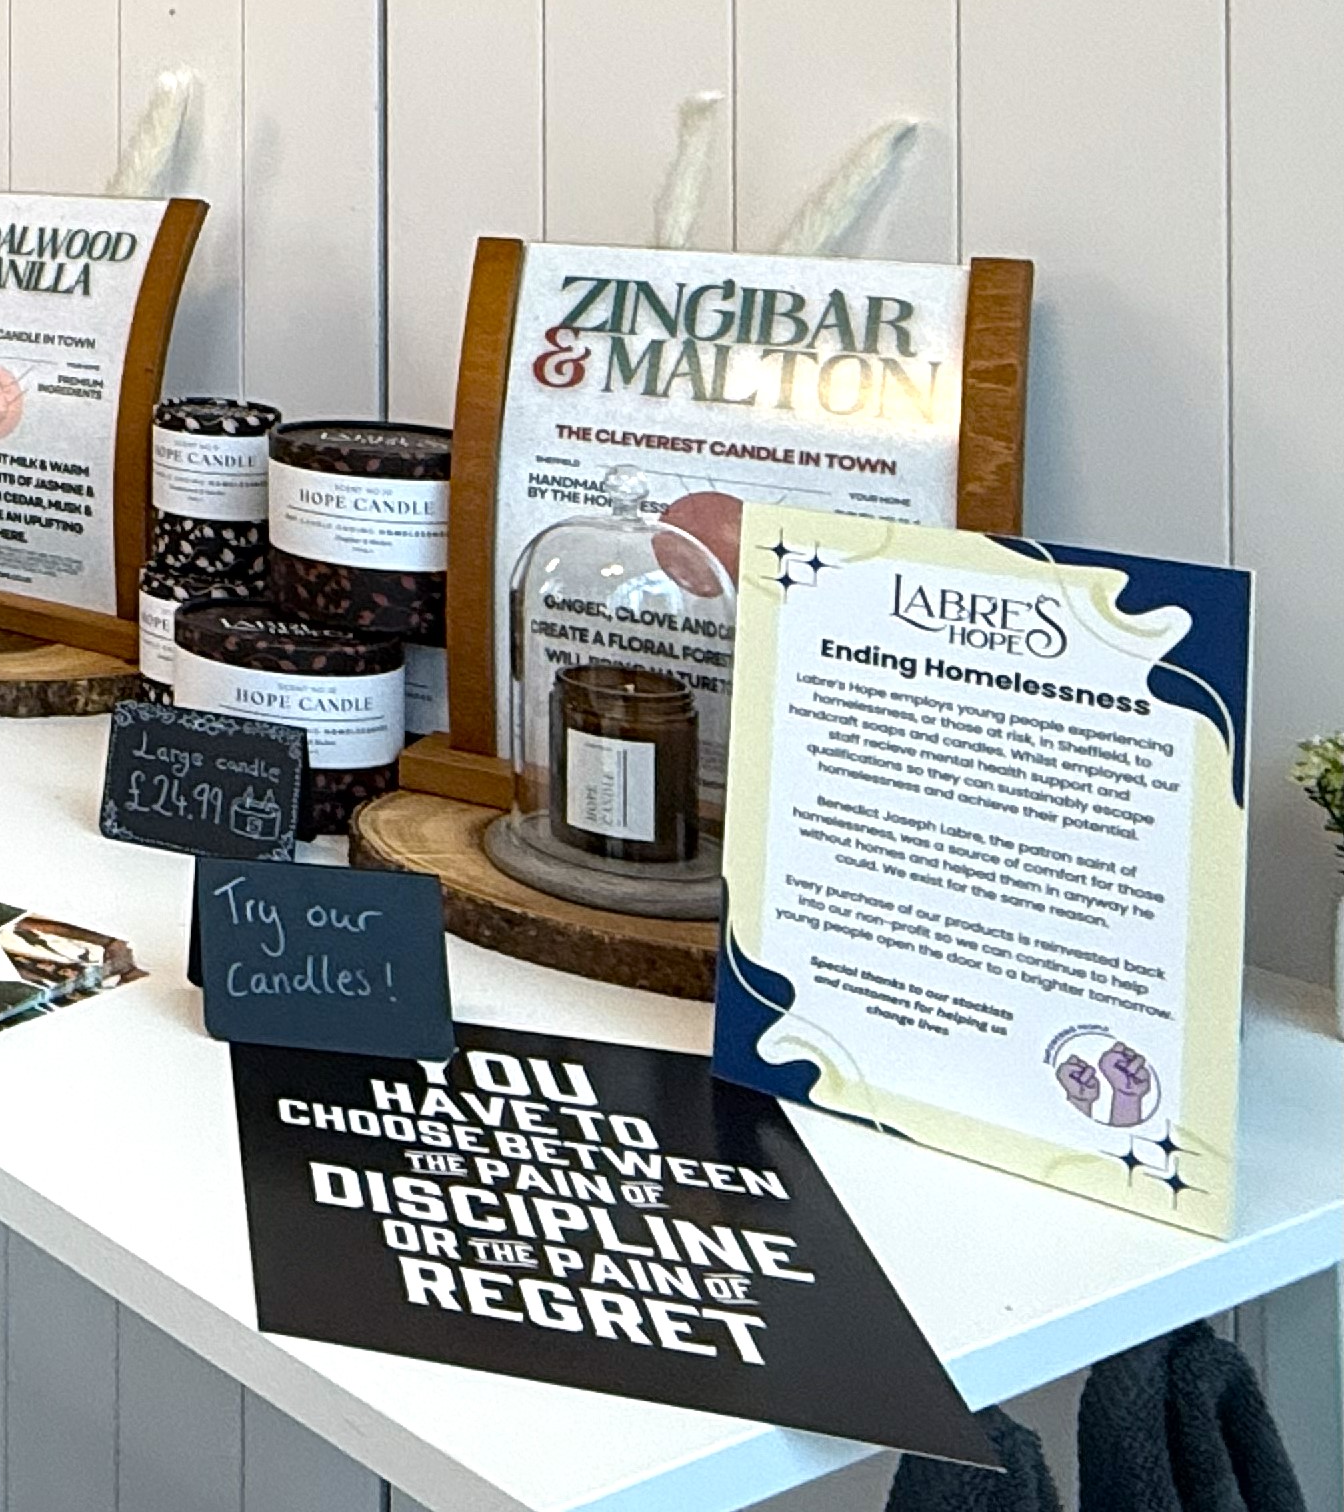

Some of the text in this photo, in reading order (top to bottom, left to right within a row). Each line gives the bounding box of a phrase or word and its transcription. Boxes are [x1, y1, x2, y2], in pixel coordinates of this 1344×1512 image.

[43, 334, 56, 346] IN
[56, 334, 97, 350] TOWN
[559, 276, 918, 359] ZINGIBAR
[532, 325, 942, 426] & MALTON
[555, 424, 898, 477] THE CLEVEREST CANDLE IN TOWN
[299, 488, 436, 517] HOPE CANDLE
[527, 487, 582, 504] BY THE
[849, 492, 912, 507] YOUR HOME
[530, 619, 679, 660] CREATE A FLORAL
[614, 605, 679, 632] CLOVE
[680, 616, 717, 638] AND
[889, 573, 1067, 658] LABRE'S
[948, 626, 1025, 656] HOPE
[236, 687, 374, 713] HOPE CANDLE
[820, 638, 1151, 716] Ending Homelessness
[787, 702, 1181, 793] handcraft soaps and candles. Whilst employed, our
[795, 670, 1174, 758] Labre's Hope employs young people experiencing
[811, 690, 1153, 769] homelessness, or those at risk, in Sheffield, to
[132, 732, 281, 783] Large candle
[123, 771, 223, 825] £24.99
[213, 876, 383, 958] Try our
[278, 1098, 789, 1199] CHOOSE BETWEEN
[370, 1078, 658, 1149] HAVE TO
[404, 1151, 667, 1207] THE PAIN OF
[310, 1162, 814, 1282] DISCIPLINE
[382, 1218, 756, 1303] OR THE PAIN OF
[398, 1256, 766, 1364] REGRET
